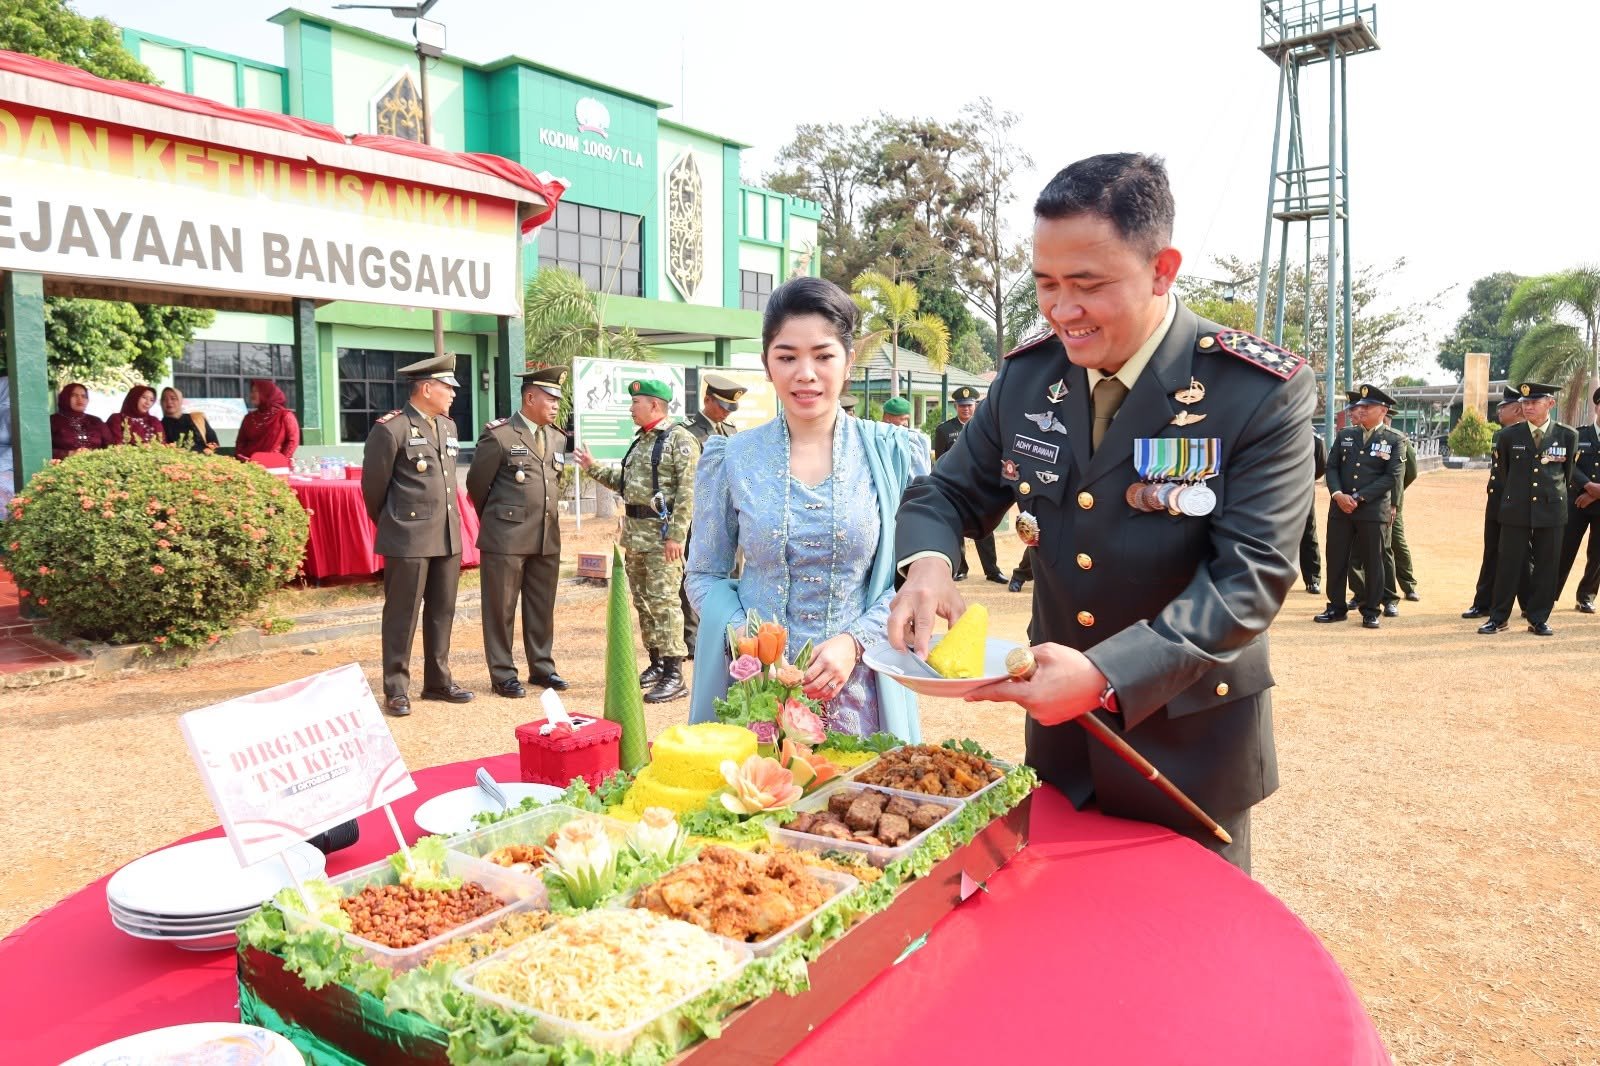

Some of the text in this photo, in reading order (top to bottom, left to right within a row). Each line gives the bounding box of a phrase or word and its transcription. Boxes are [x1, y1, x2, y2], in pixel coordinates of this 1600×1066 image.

[539, 128, 644, 168] KODIM 1009/TLA
[263, 232, 490, 299] BANGSAKU
[1278, 356, 1299, 373] TNI
[1015, 440, 1055, 459] ADHY IRAWAN
[229, 710, 364, 772] DIRGAHAYU
[251, 761, 299, 793] TNI
